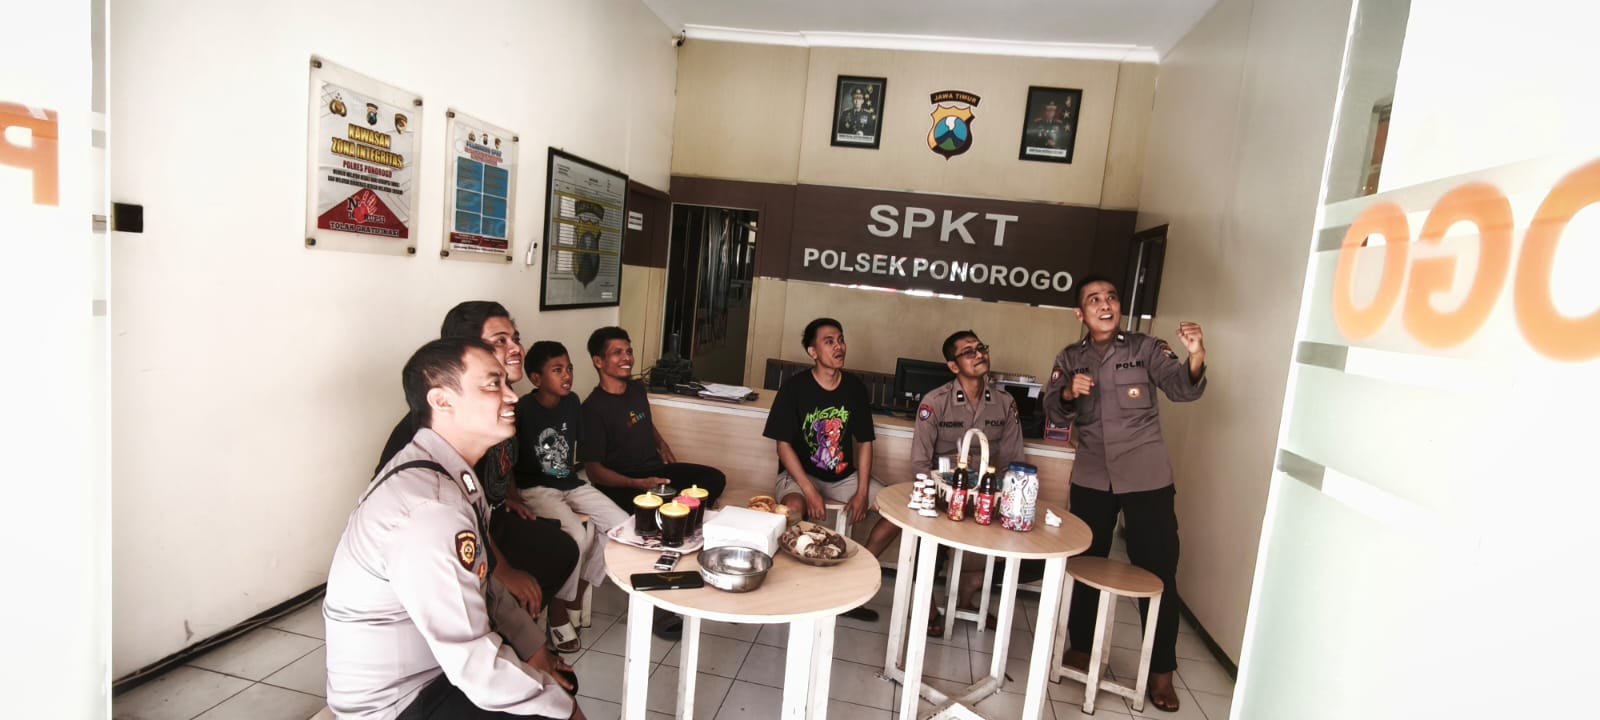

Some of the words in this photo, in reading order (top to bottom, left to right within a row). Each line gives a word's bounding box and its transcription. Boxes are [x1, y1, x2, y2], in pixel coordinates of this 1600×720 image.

[934, 92, 954, 102] JAWA
[955, 93, 977, 105] TIMUR
[348, 123, 391, 149] KAWASAN
[331, 137, 355, 158] ZONA
[356, 144, 404, 171] INTEGRITAS
[867, 204, 1019, 247] SPKT
[803, 247, 907, 277] POLSEK
[912, 257, 1073, 292] PONOROGO
[1115, 360, 1145, 370] POLRI
